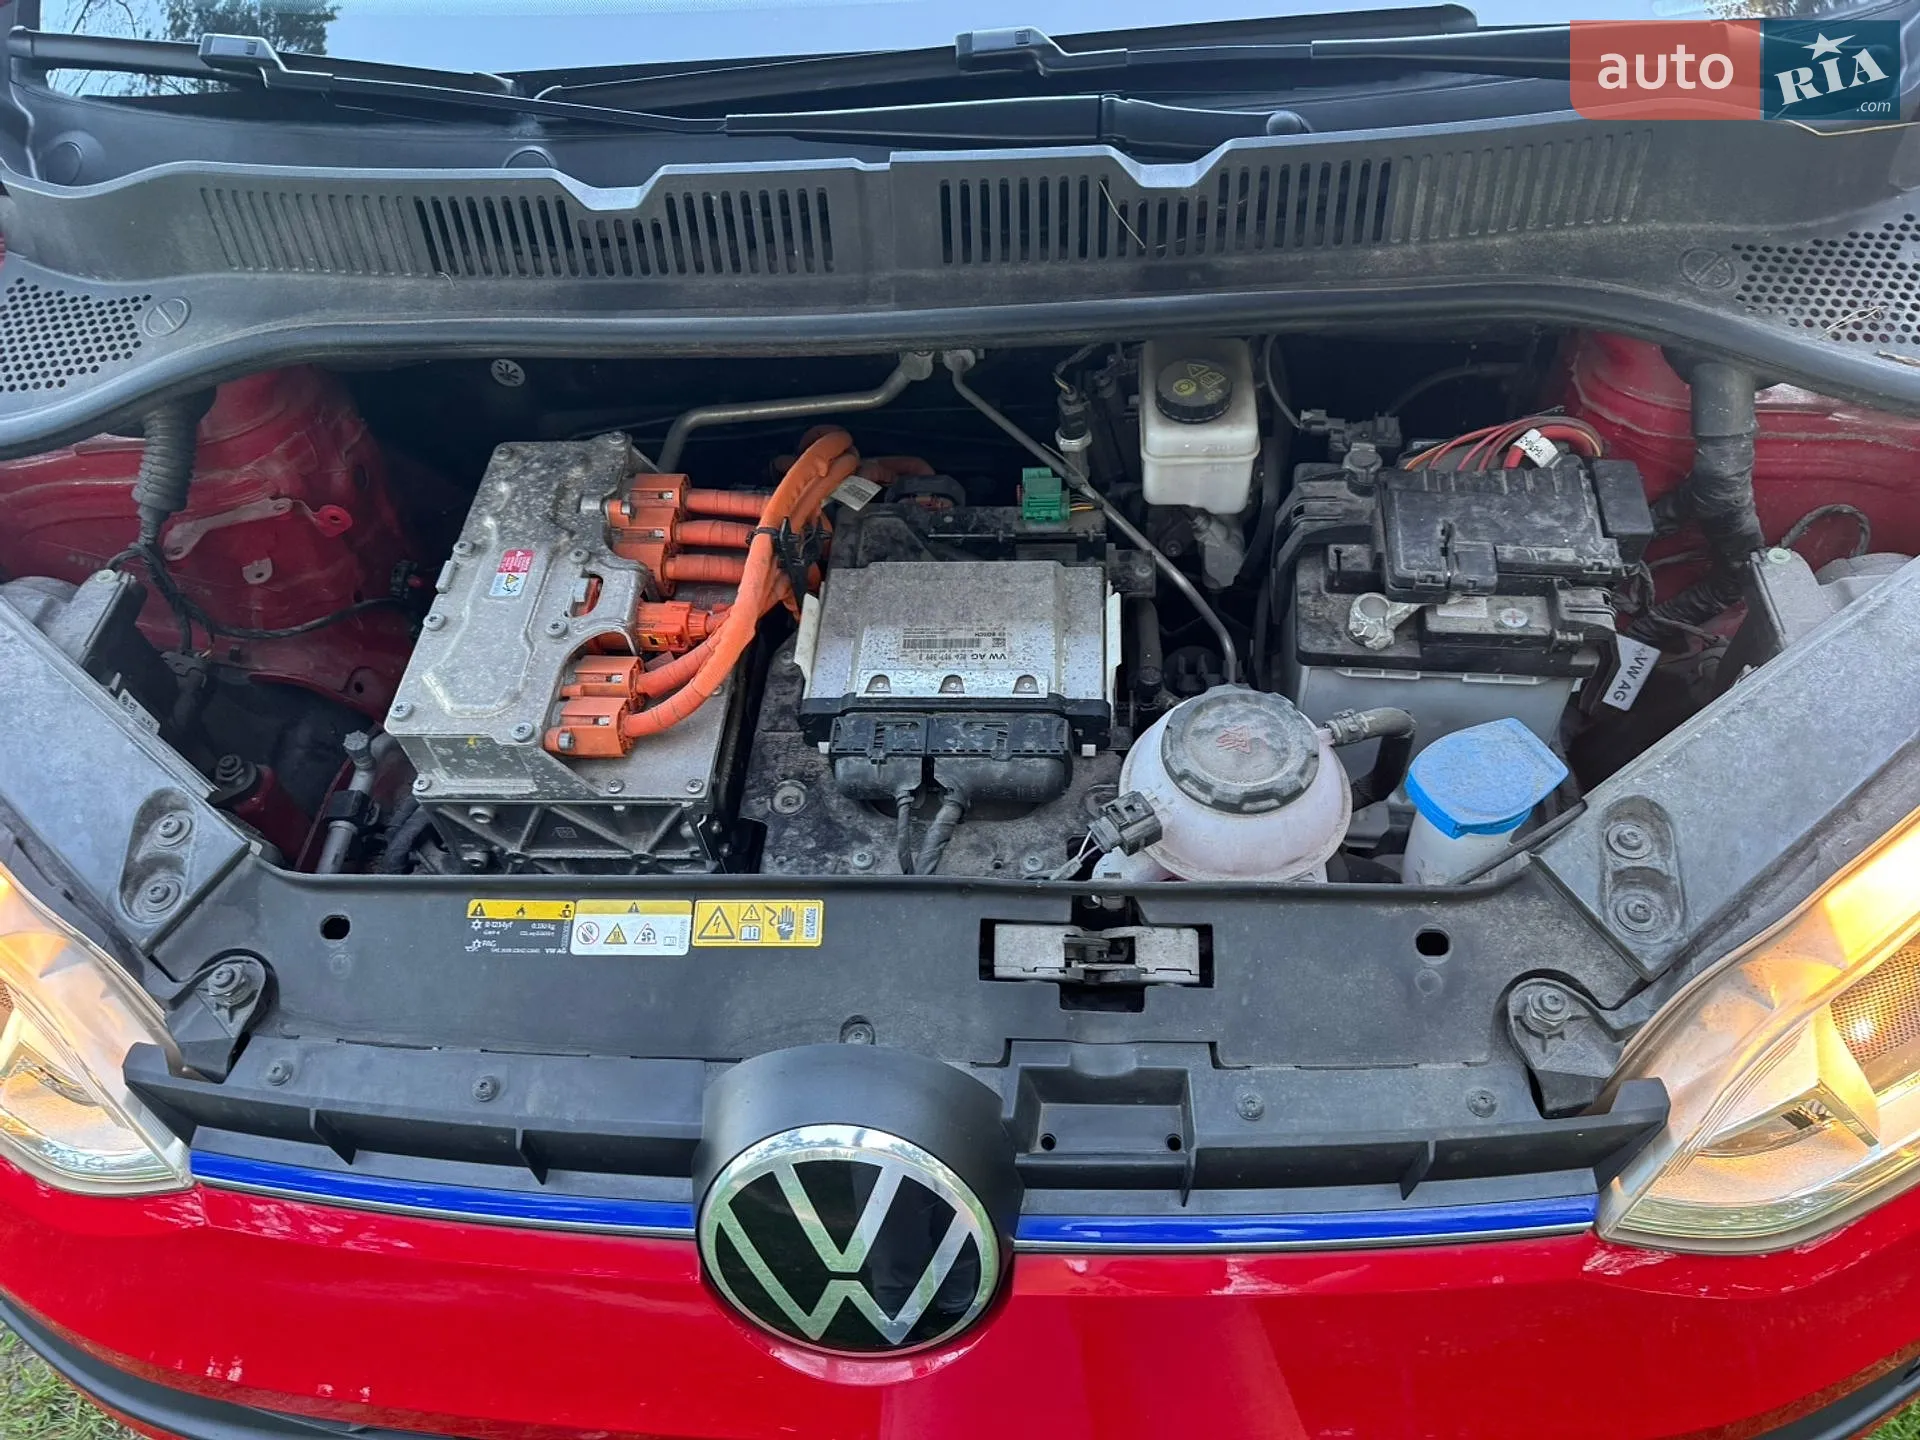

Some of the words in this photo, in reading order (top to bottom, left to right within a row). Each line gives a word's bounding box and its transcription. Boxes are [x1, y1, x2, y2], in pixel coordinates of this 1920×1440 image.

[1626, 657, 1649, 679] VW
[1613, 680, 1631, 701] AG
[700, 1128, 999, 1354] VW
